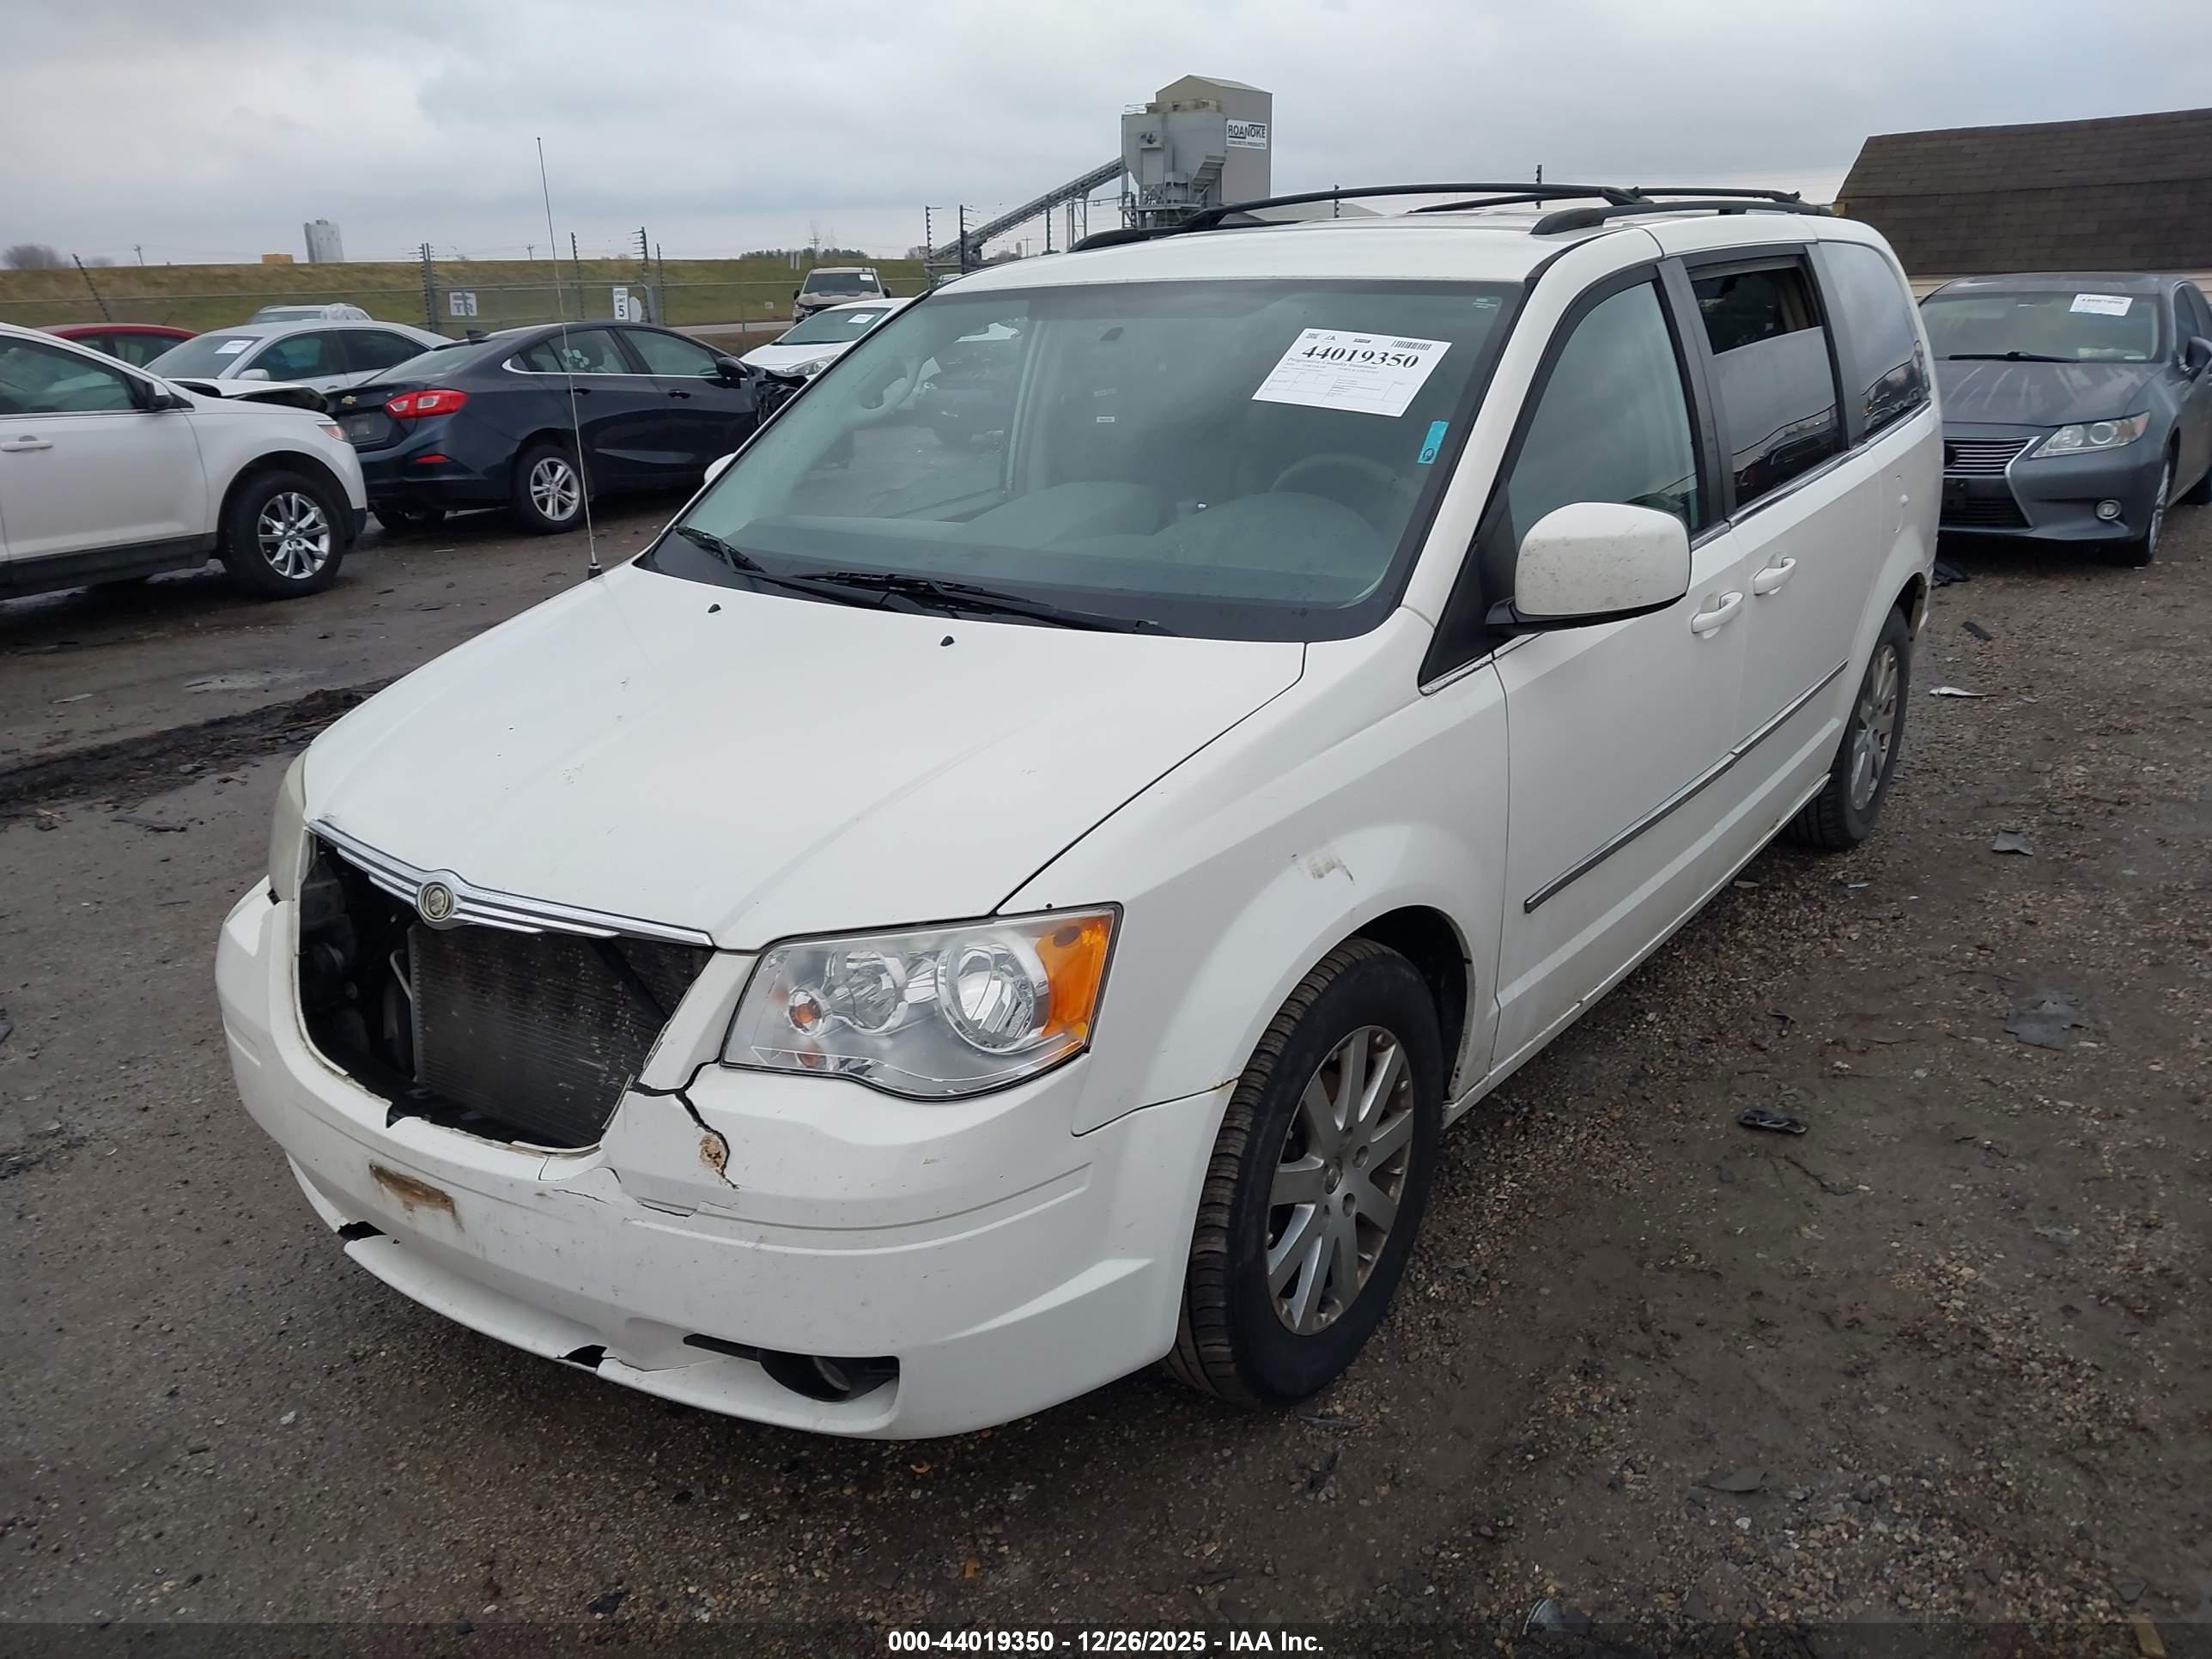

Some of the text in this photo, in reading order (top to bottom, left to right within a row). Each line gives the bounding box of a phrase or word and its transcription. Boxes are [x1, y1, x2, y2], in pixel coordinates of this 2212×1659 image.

[1228, 125, 1265, 138] ROANOKE
[618, 304, 625, 318] 5
[1302, 345, 1419, 368] 44019350
